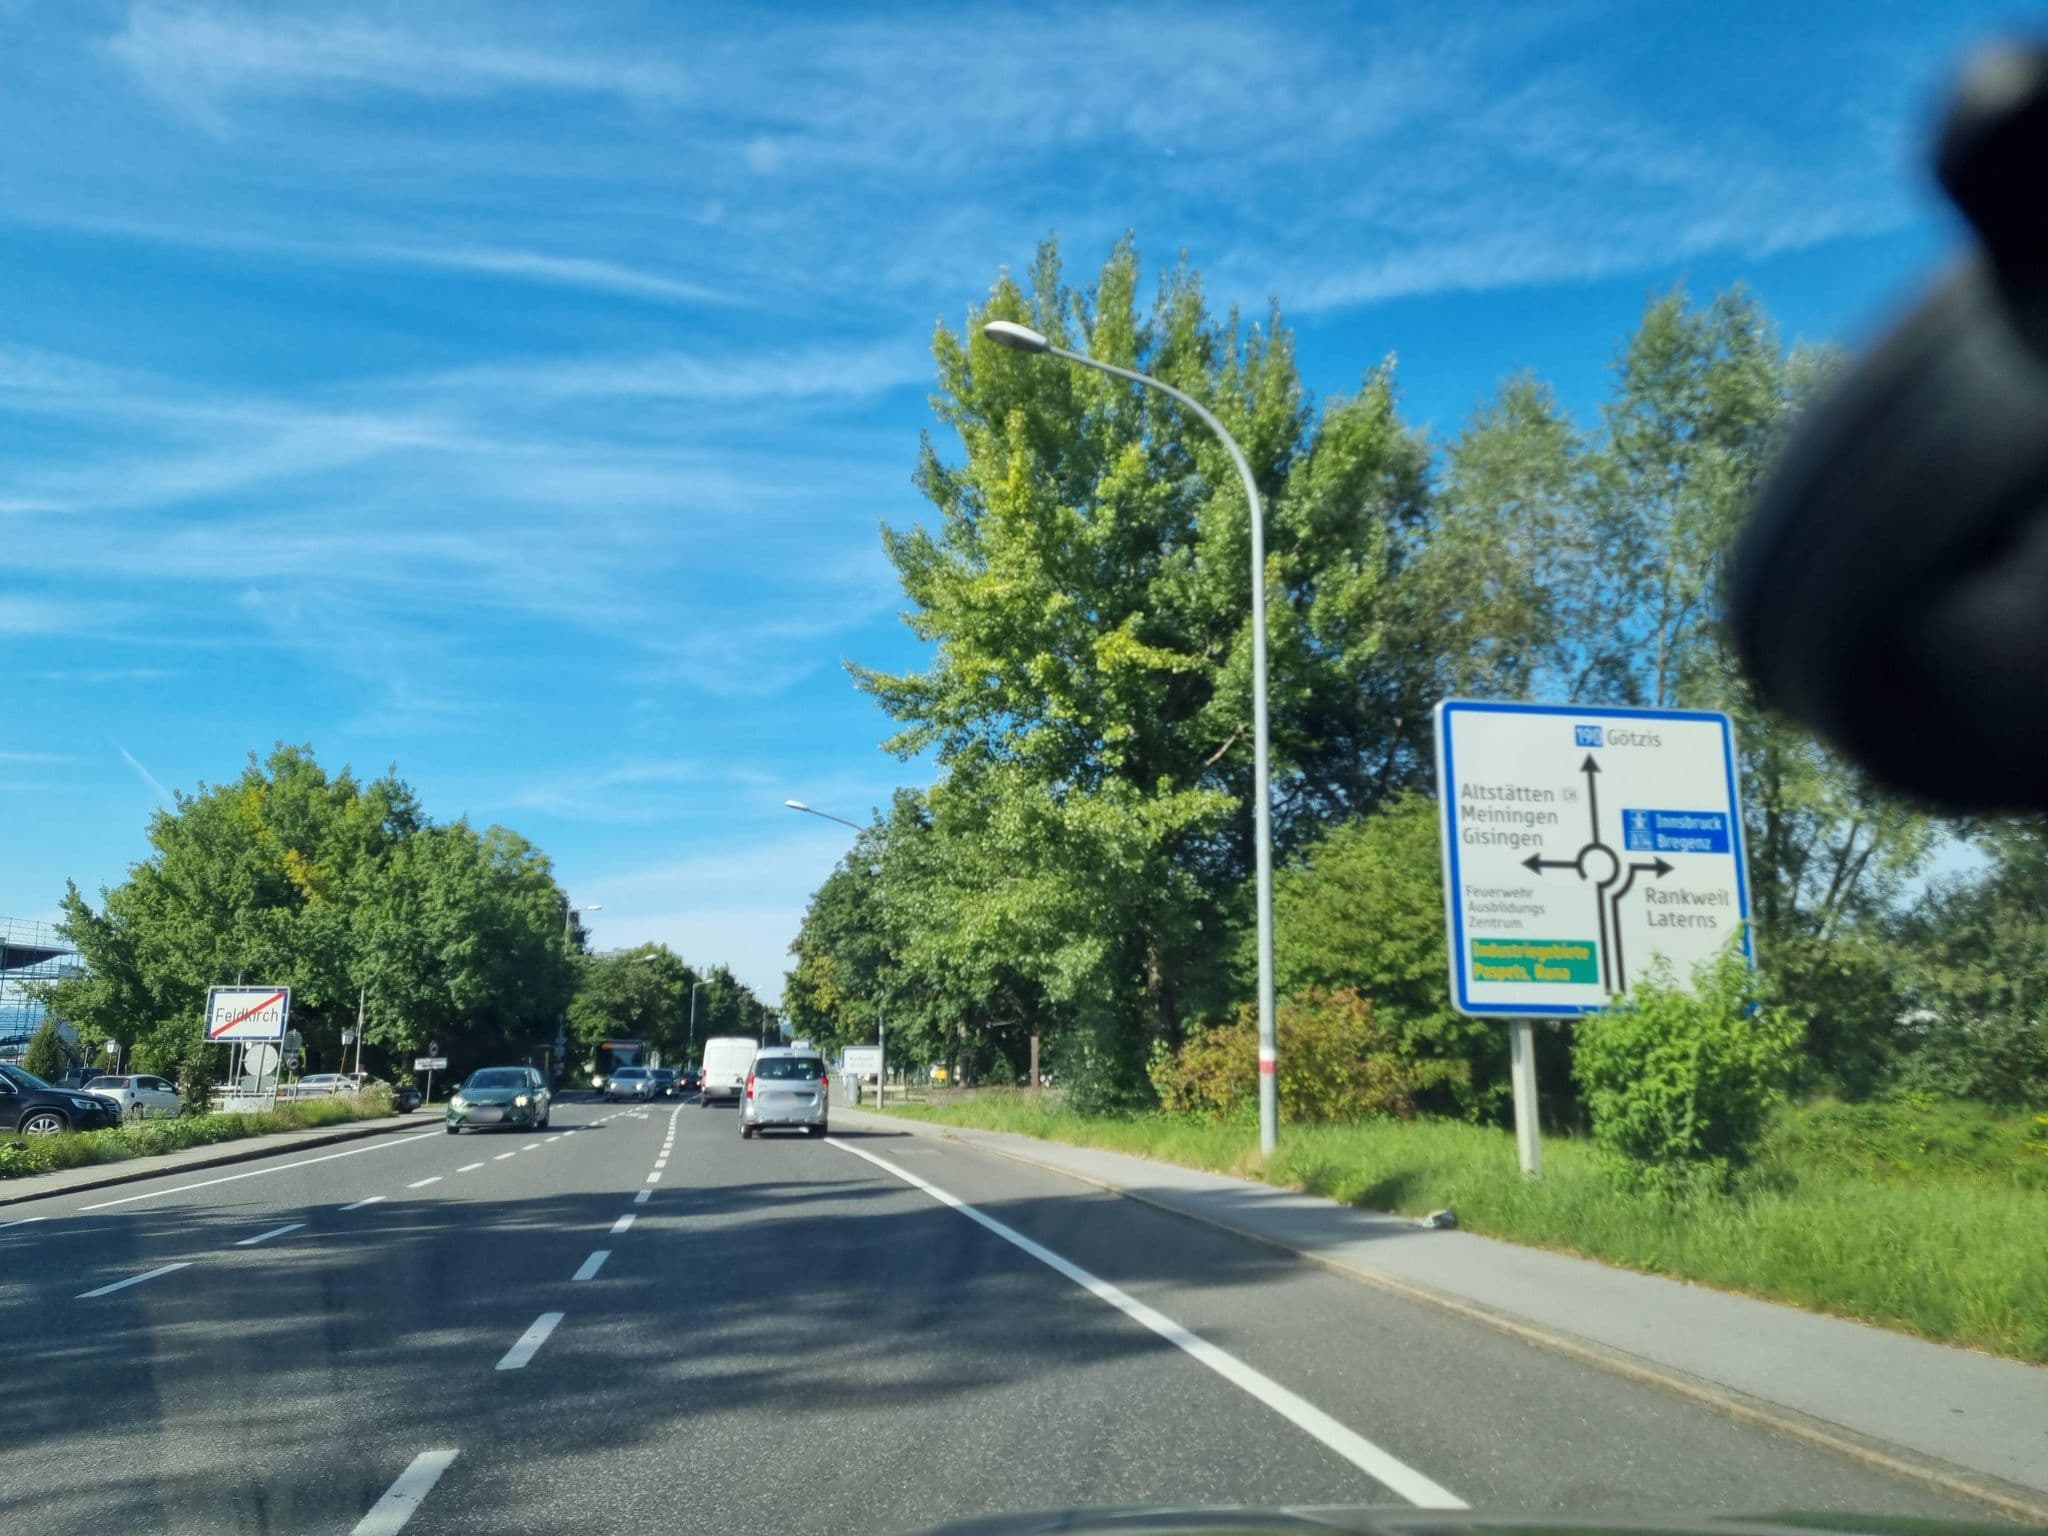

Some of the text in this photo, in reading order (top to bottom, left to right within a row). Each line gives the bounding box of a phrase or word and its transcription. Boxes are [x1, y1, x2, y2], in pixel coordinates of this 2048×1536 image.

[1607, 729, 1662, 747] Götzis
[1461, 783, 1554, 803] Altstätten
[1461, 805, 1558, 827] Meiningen
[1463, 829, 1543, 850] Gisingen
[1465, 885, 1533, 899] Feuerwehr
[1645, 887, 1730, 907] Rankweil
[1468, 901, 1545, 917] Ausbildungs
[1468, 916, 1524, 929] Zentrum
[1648, 910, 1717, 929] Laterns
[215, 1007, 278, 1023] Feldkirch
